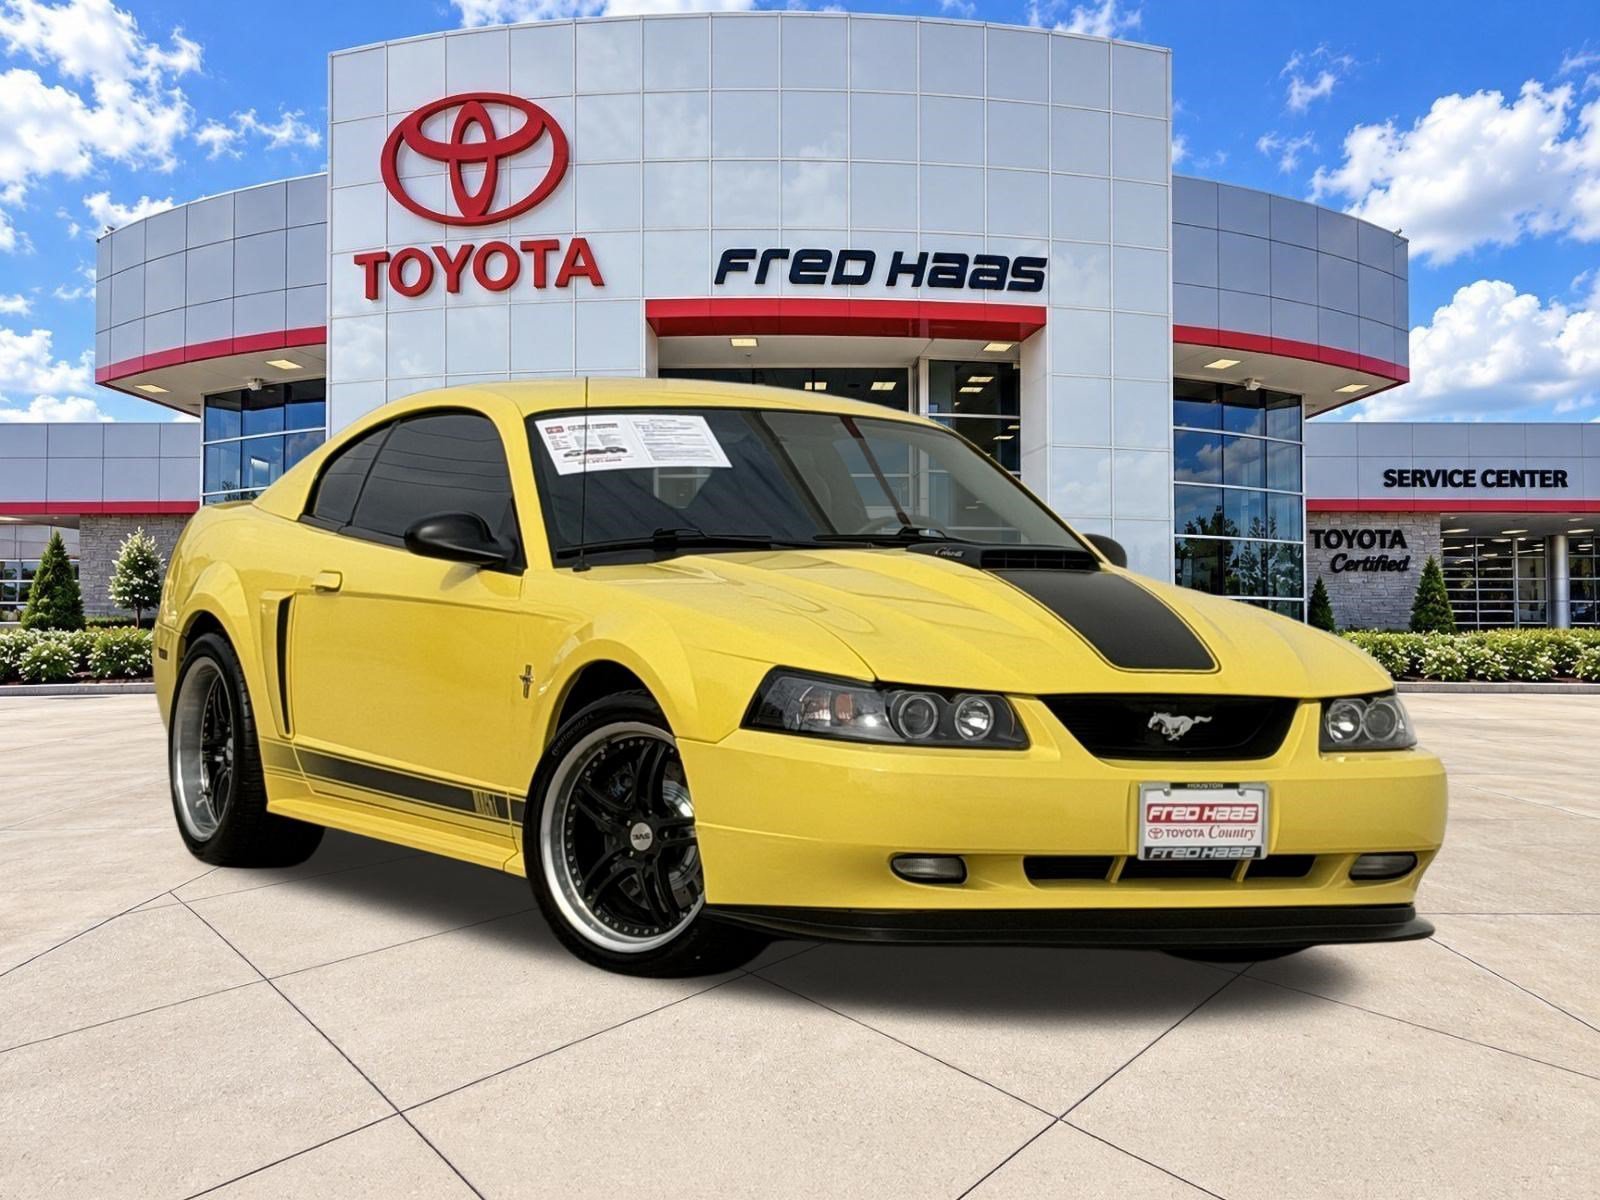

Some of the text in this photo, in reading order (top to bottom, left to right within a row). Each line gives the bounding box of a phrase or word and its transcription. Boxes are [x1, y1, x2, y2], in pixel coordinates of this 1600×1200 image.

[354, 237, 605, 301] TOYOTA
[886, 251, 1048, 292] Haas
[1383, 469, 1568, 488] SERVICE CENTER
[1309, 529, 1408, 549] TOYOTA
[1330, 553, 1411, 573] Certified
[1202, 806, 1257, 820] Haas
[1166, 825, 1256, 841] TOYOTA Country
[1201, 847, 1256, 859] Haas
